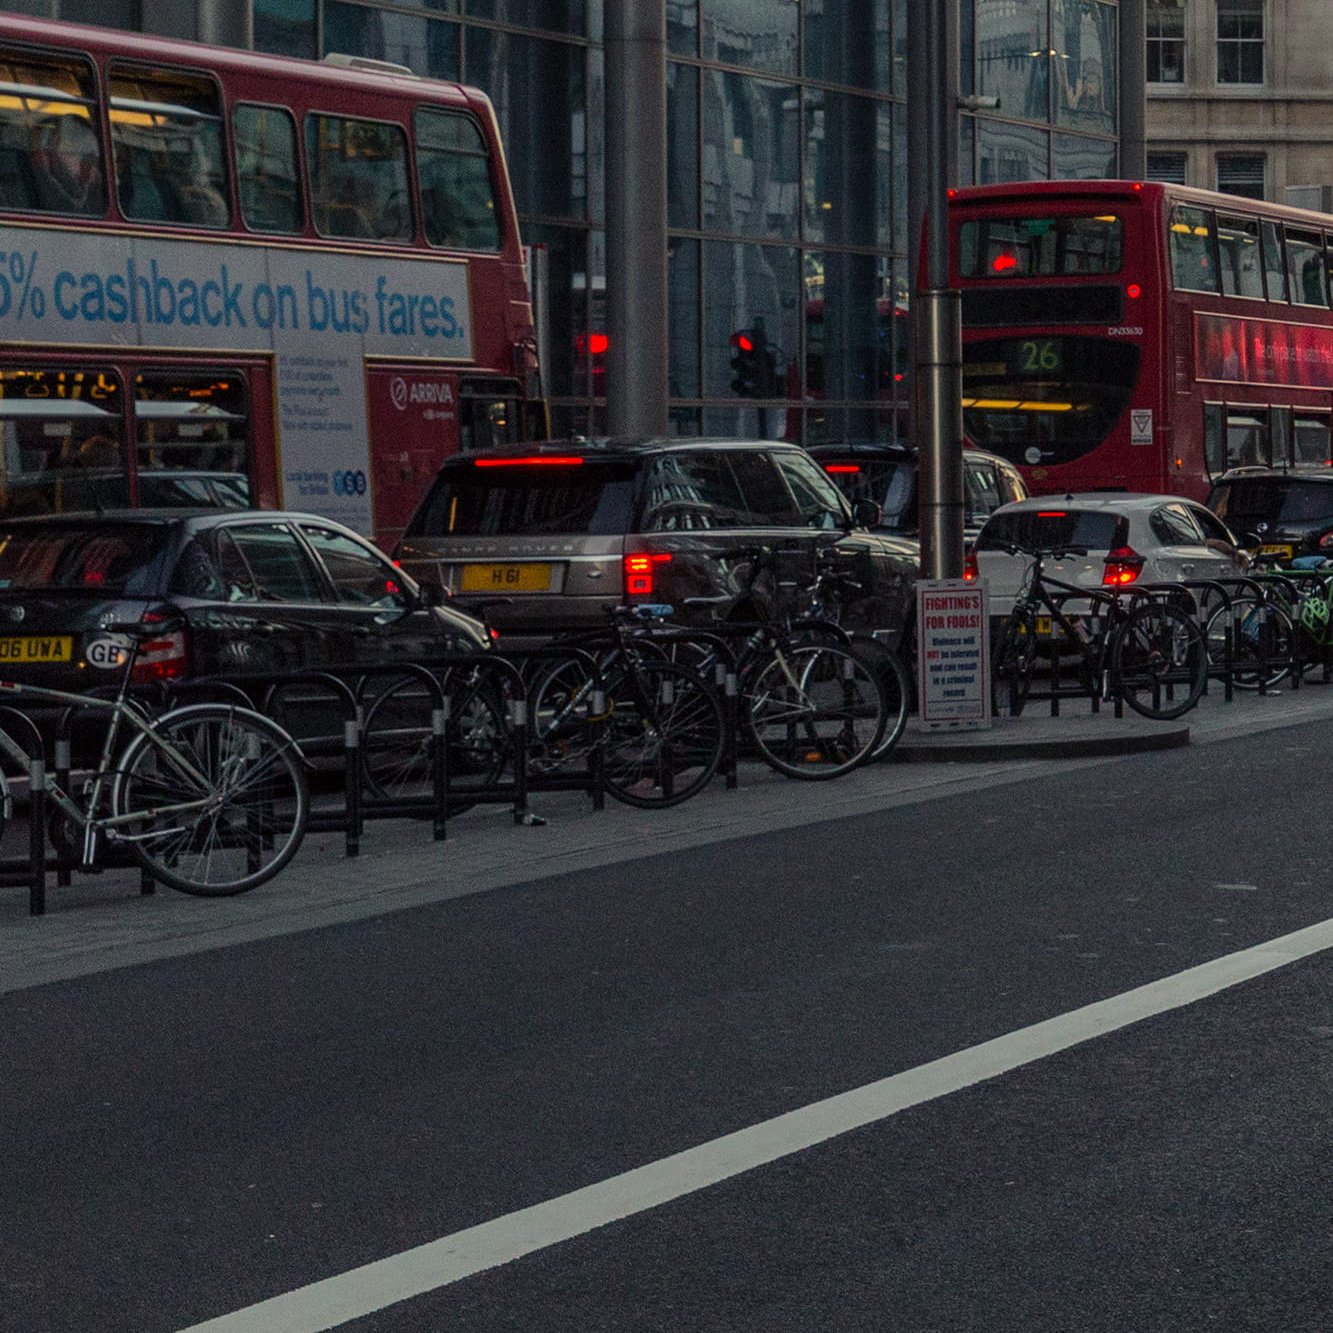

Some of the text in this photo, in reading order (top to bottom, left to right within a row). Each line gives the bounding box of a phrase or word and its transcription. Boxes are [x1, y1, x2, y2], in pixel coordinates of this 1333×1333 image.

[53, 258, 247, 330] cashback
[252, 283, 299, 330] on
[305, 269, 370, 334] bus
[375, 275, 465, 339] fares.
[1021, 341, 1058, 371] 26
[409, 383, 455, 403] ARRIVA
[925, 595, 979, 610] FIGHTING'S
[926, 614, 980, 629] FOR FOOLS!
[27, 639, 63, 657] UWA
[91, 644, 121, 664] GB
